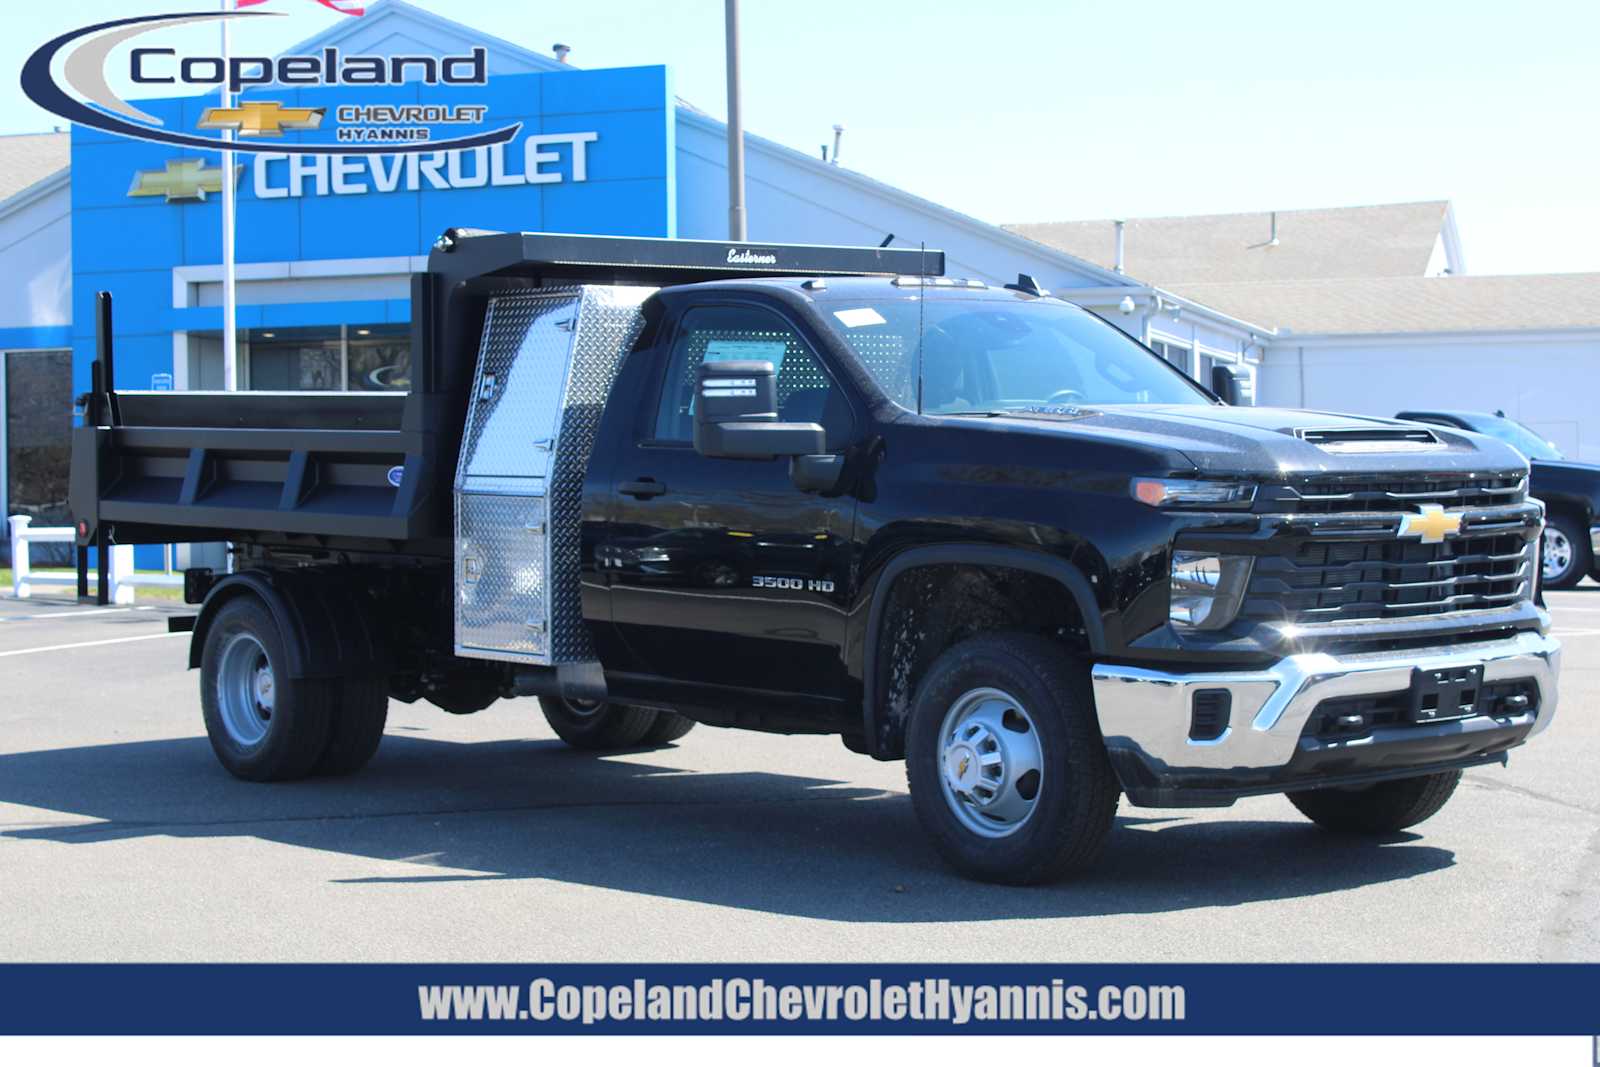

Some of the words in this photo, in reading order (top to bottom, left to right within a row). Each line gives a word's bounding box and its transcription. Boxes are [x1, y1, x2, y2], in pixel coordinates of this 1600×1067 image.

[254, 131, 598, 199] CHEVROLET
[752, 575, 803, 590] 3500
[808, 579, 834, 592] HD
